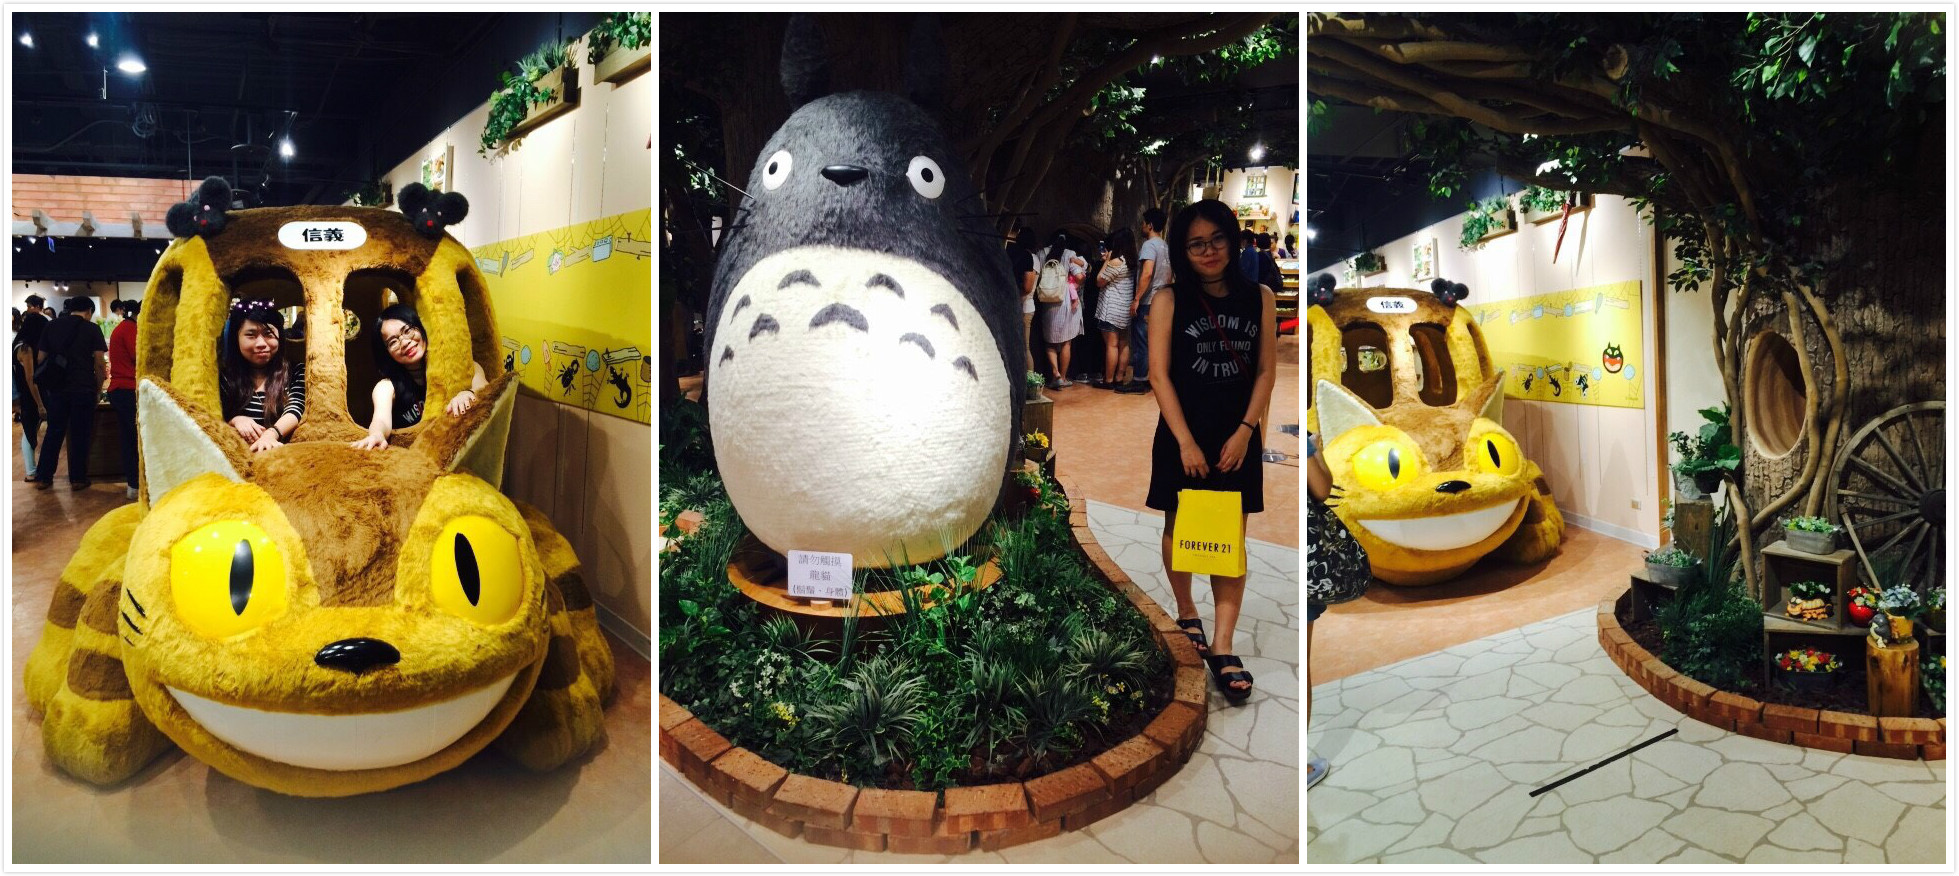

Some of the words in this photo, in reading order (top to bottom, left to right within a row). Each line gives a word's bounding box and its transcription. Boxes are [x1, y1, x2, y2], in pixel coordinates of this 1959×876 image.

[302, 227, 344, 242] 信義
[1244, 320, 1258, 338] IS
[1196, 341, 1216, 353] ONLY
[1191, 356, 1209, 374] IN
[1180, 540, 1219, 553] FOREVER
[1221, 543, 1232, 554] 21
[798, 554, 842, 567] 請勿觸摸
[810, 570, 831, 580] 龍貓
